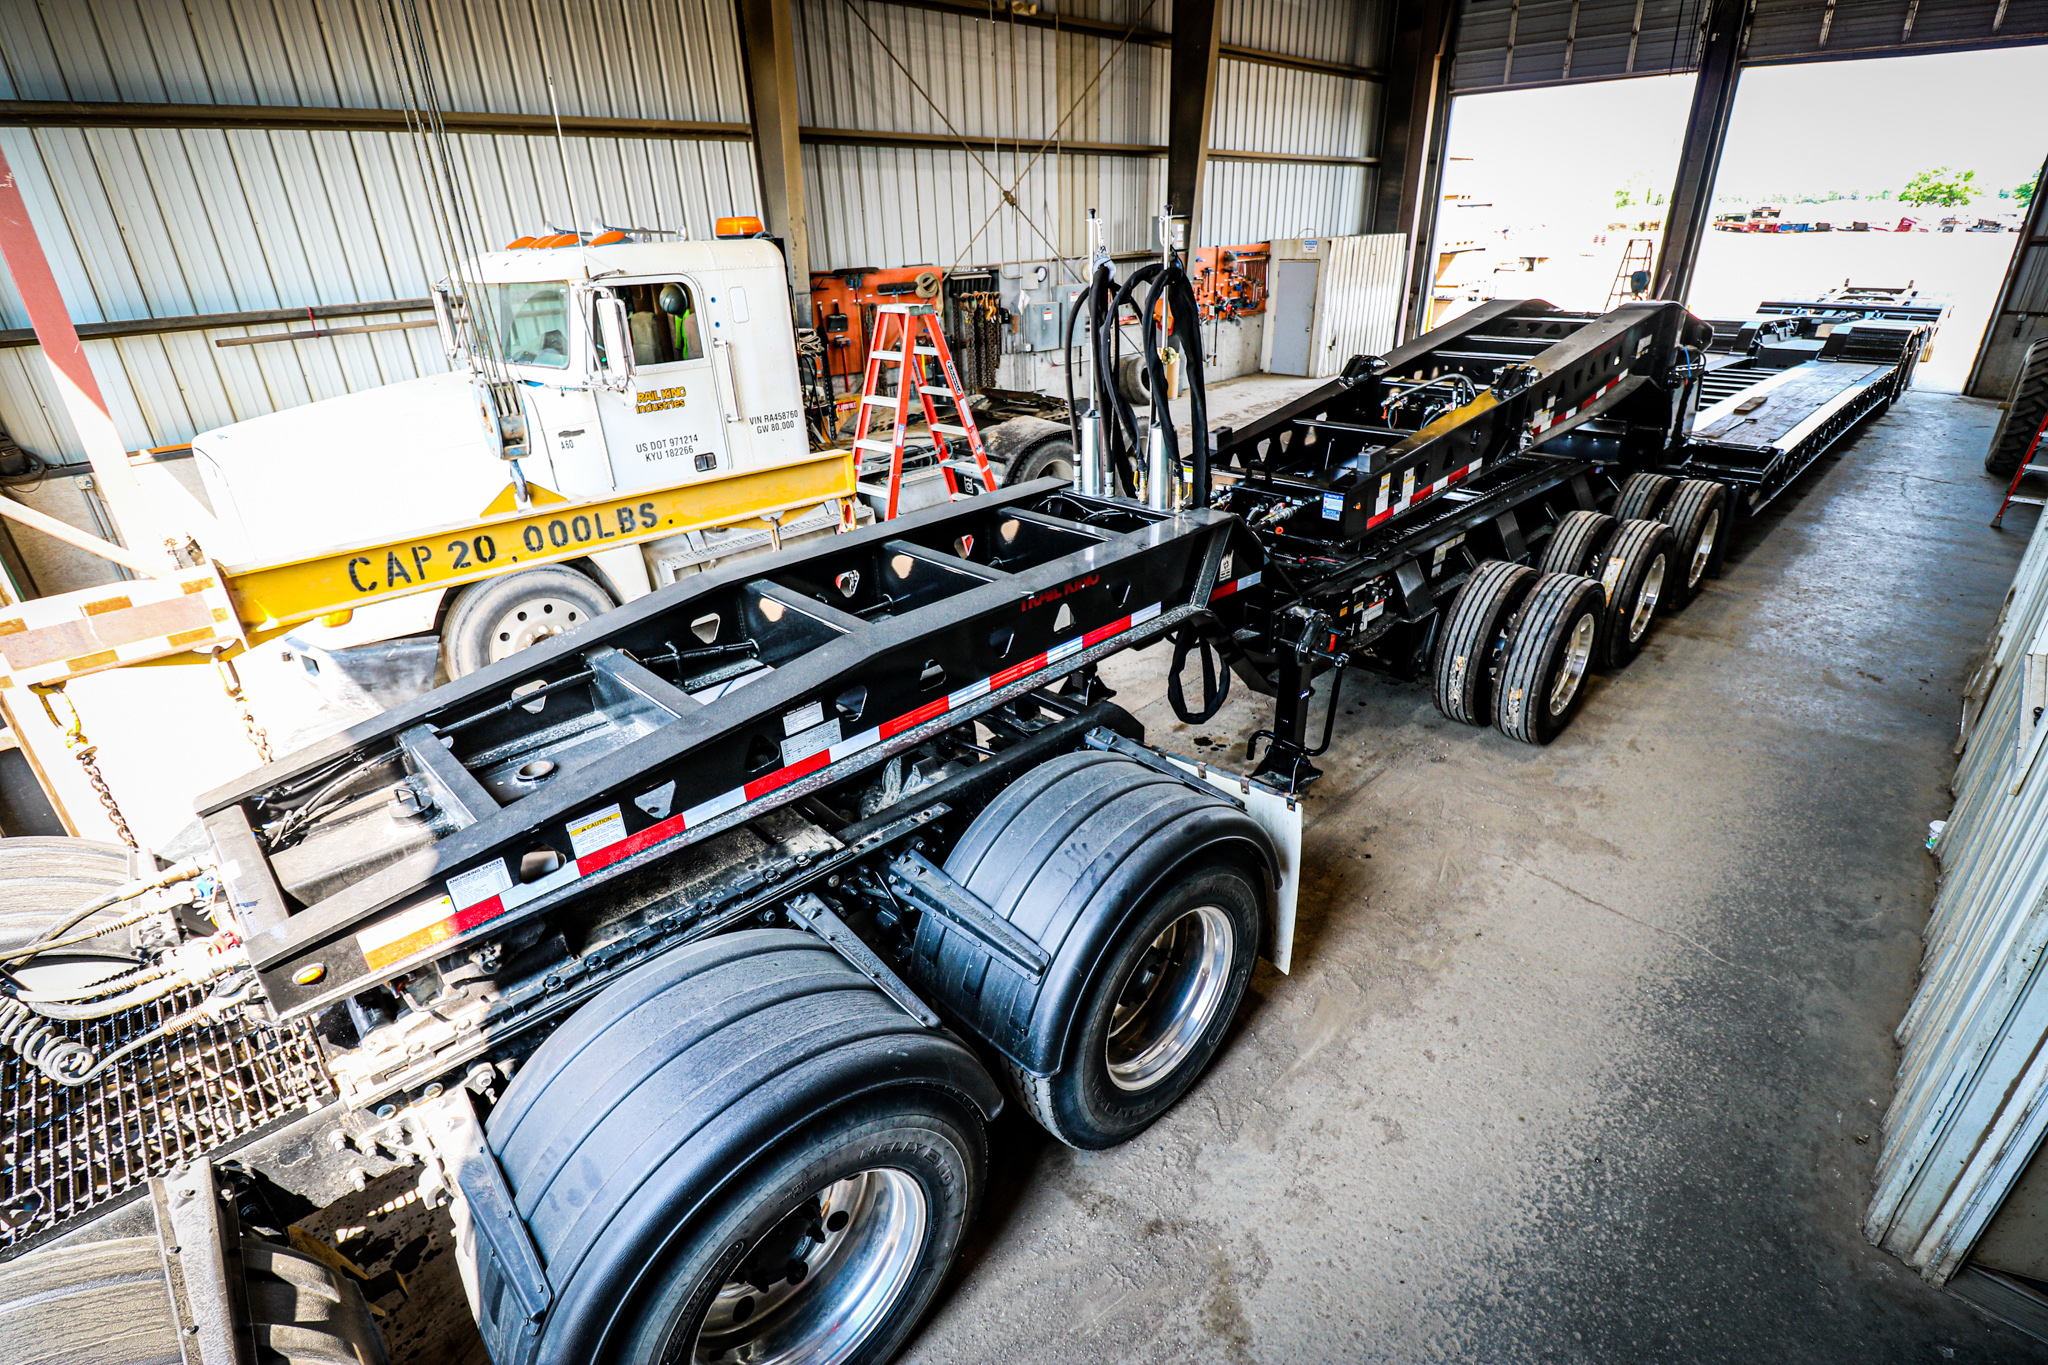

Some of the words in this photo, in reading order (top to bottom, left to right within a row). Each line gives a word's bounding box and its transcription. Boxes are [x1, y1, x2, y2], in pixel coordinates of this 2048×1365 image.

[637, 390, 661, 403] RAIL
[636, 399, 685, 414] Industries
[749, 416, 762, 425] VIN
[764, 409, 799, 423] RA458760
[757, 424, 769, 434] GW
[636, 443, 648, 453] US
[650, 439, 667, 451] DOT
[669, 433, 698, 447] 971214
[645, 451, 663, 462] KYU
[665, 444, 694, 458] 182266
[348, 545, 432, 593] CAP
